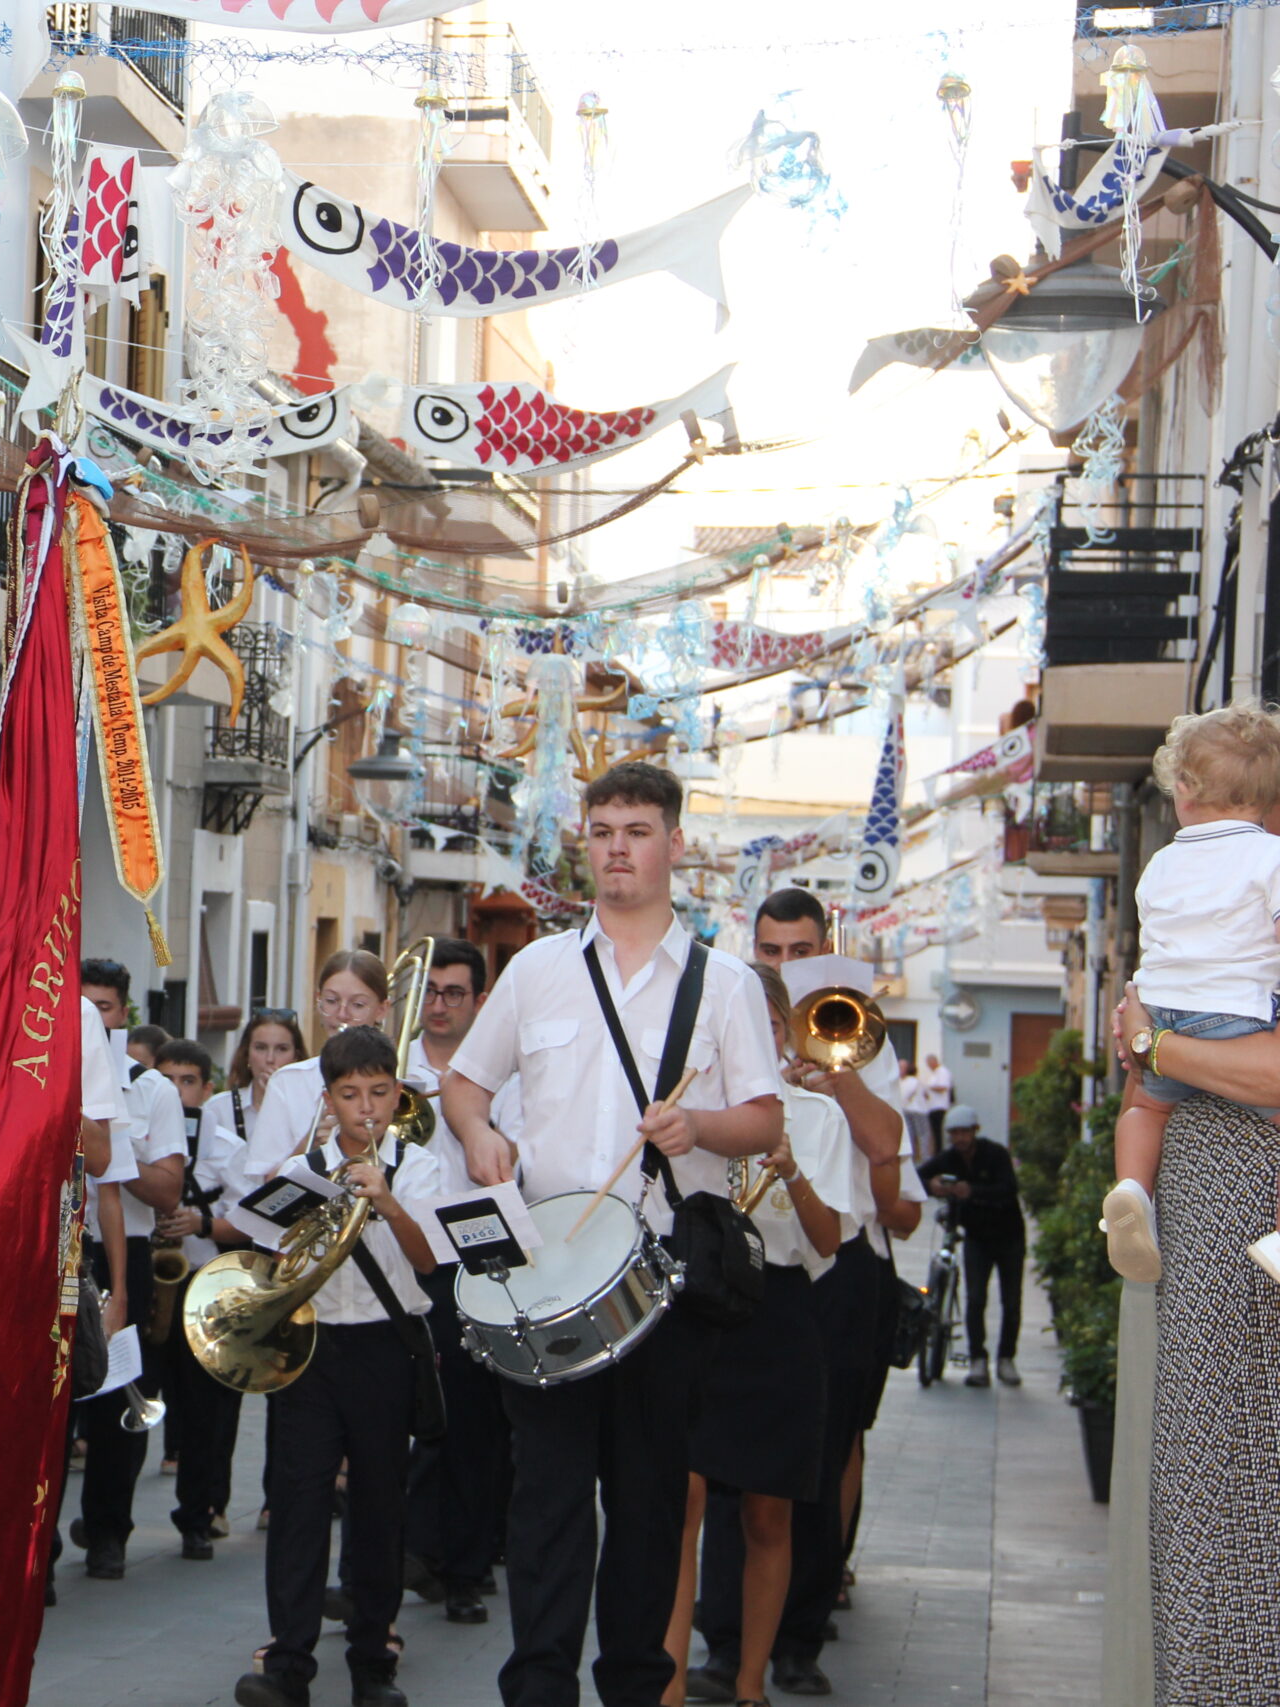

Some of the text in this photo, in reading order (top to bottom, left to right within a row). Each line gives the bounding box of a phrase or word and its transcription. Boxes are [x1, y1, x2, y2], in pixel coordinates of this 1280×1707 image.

[93, 584, 111, 620] Visita
[96, 620, 115, 654] Camp
[101, 655, 120, 668] de
[103, 668, 127, 717] Mestalla
[110, 723, 131, 759] Temp.
[116, 758, 141, 810] 2014-2015
